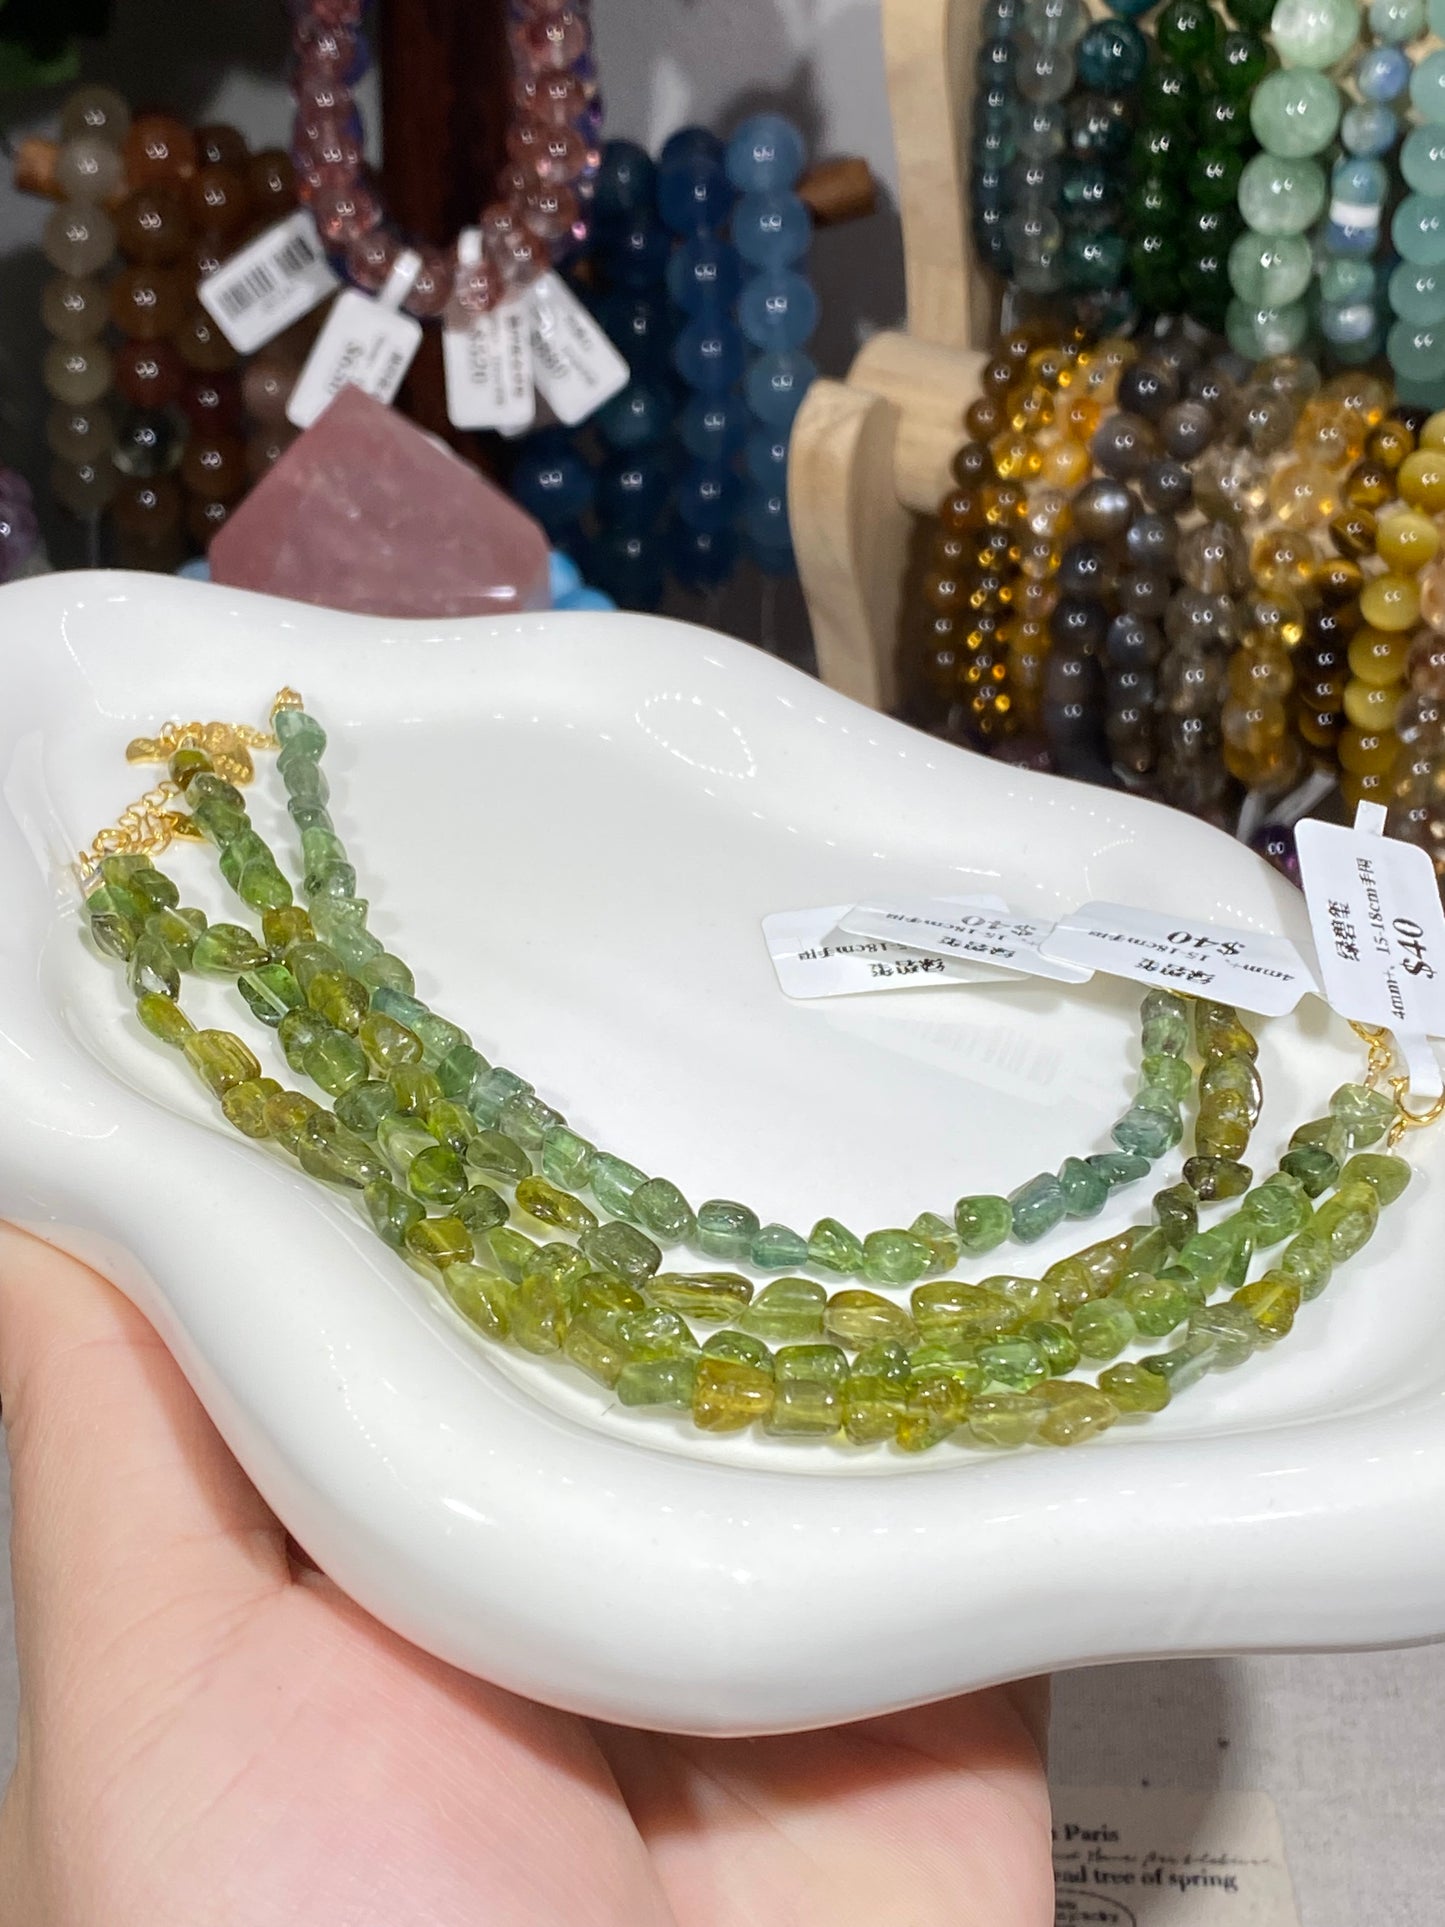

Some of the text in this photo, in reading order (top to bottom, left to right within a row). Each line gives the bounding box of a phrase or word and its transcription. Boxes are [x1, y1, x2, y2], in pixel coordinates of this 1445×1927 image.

[961, 915, 1038, 937] $40
[1166, 930, 1246, 957] $40
[1393, 917, 1438, 980] $40
[1064, 1823, 1119, 1842] Paris
[1093, 1869, 1135, 1884] tree
[1141, 1867, 1163, 1885] of
[1169, 1868, 1238, 1892] spring
